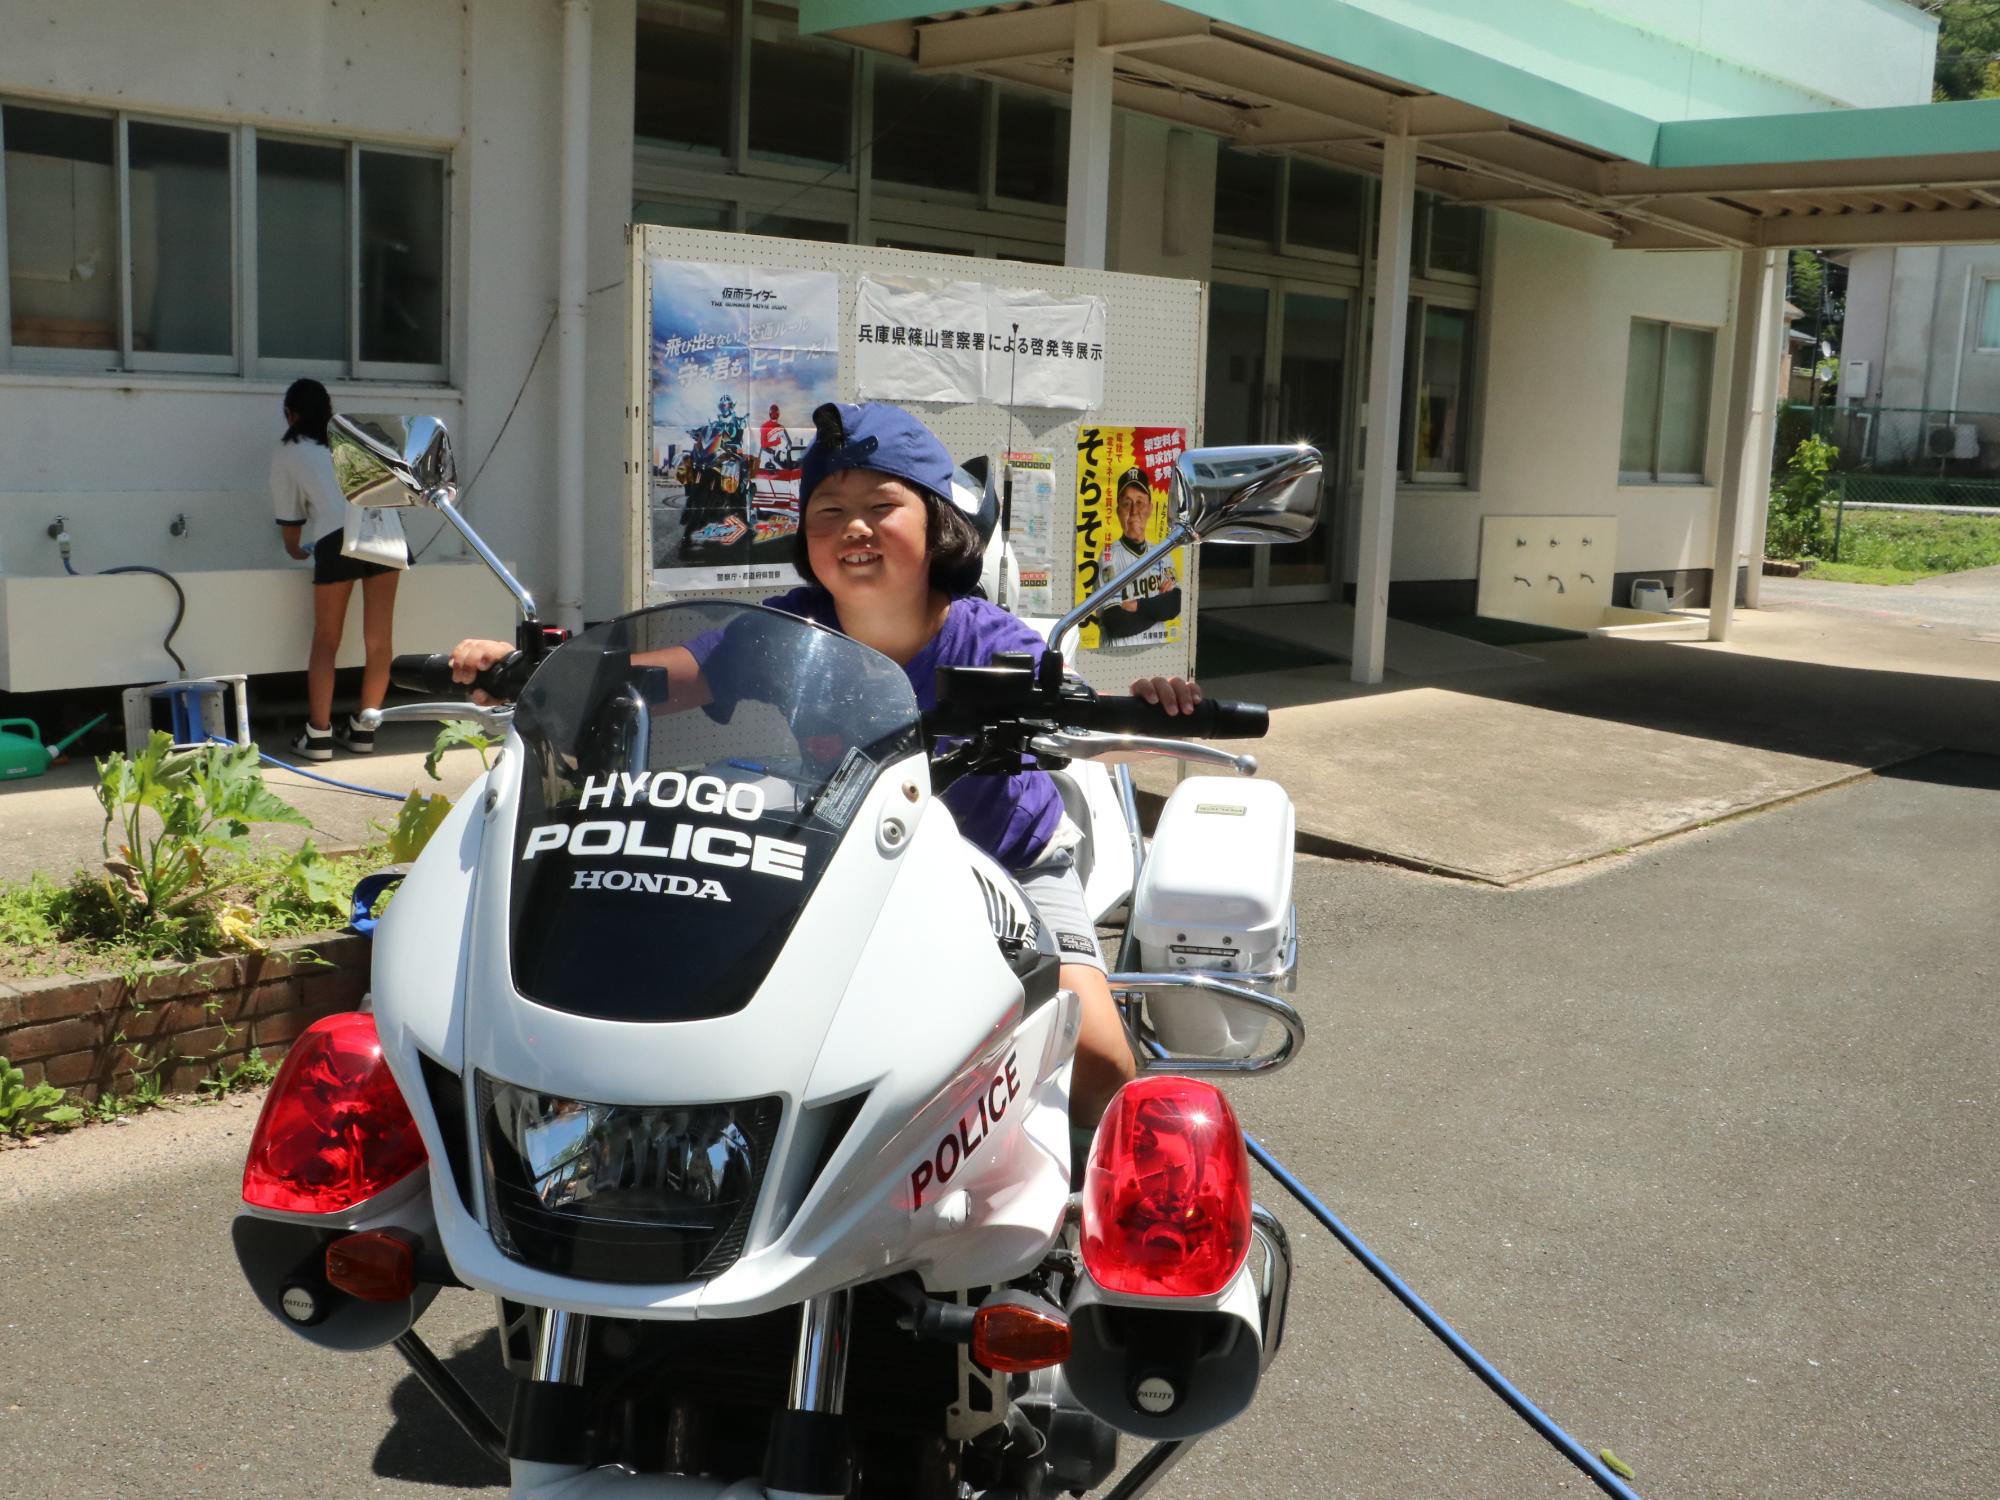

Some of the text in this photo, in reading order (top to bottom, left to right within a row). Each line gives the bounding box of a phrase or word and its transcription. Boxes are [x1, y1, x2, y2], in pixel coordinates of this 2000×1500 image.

[722, 287, 777, 301] 仮面ライダー
[858, 324, 1103, 361] 兵庫県篠山警察署による啓発等展示
[579, 771, 765, 821] HYOGO
[522, 820, 807, 881] POLICE
[570, 870, 731, 902] HONDA
[912, 1051, 1021, 1213] POLICE
[283, 1299, 312, 1308] PATLITE
